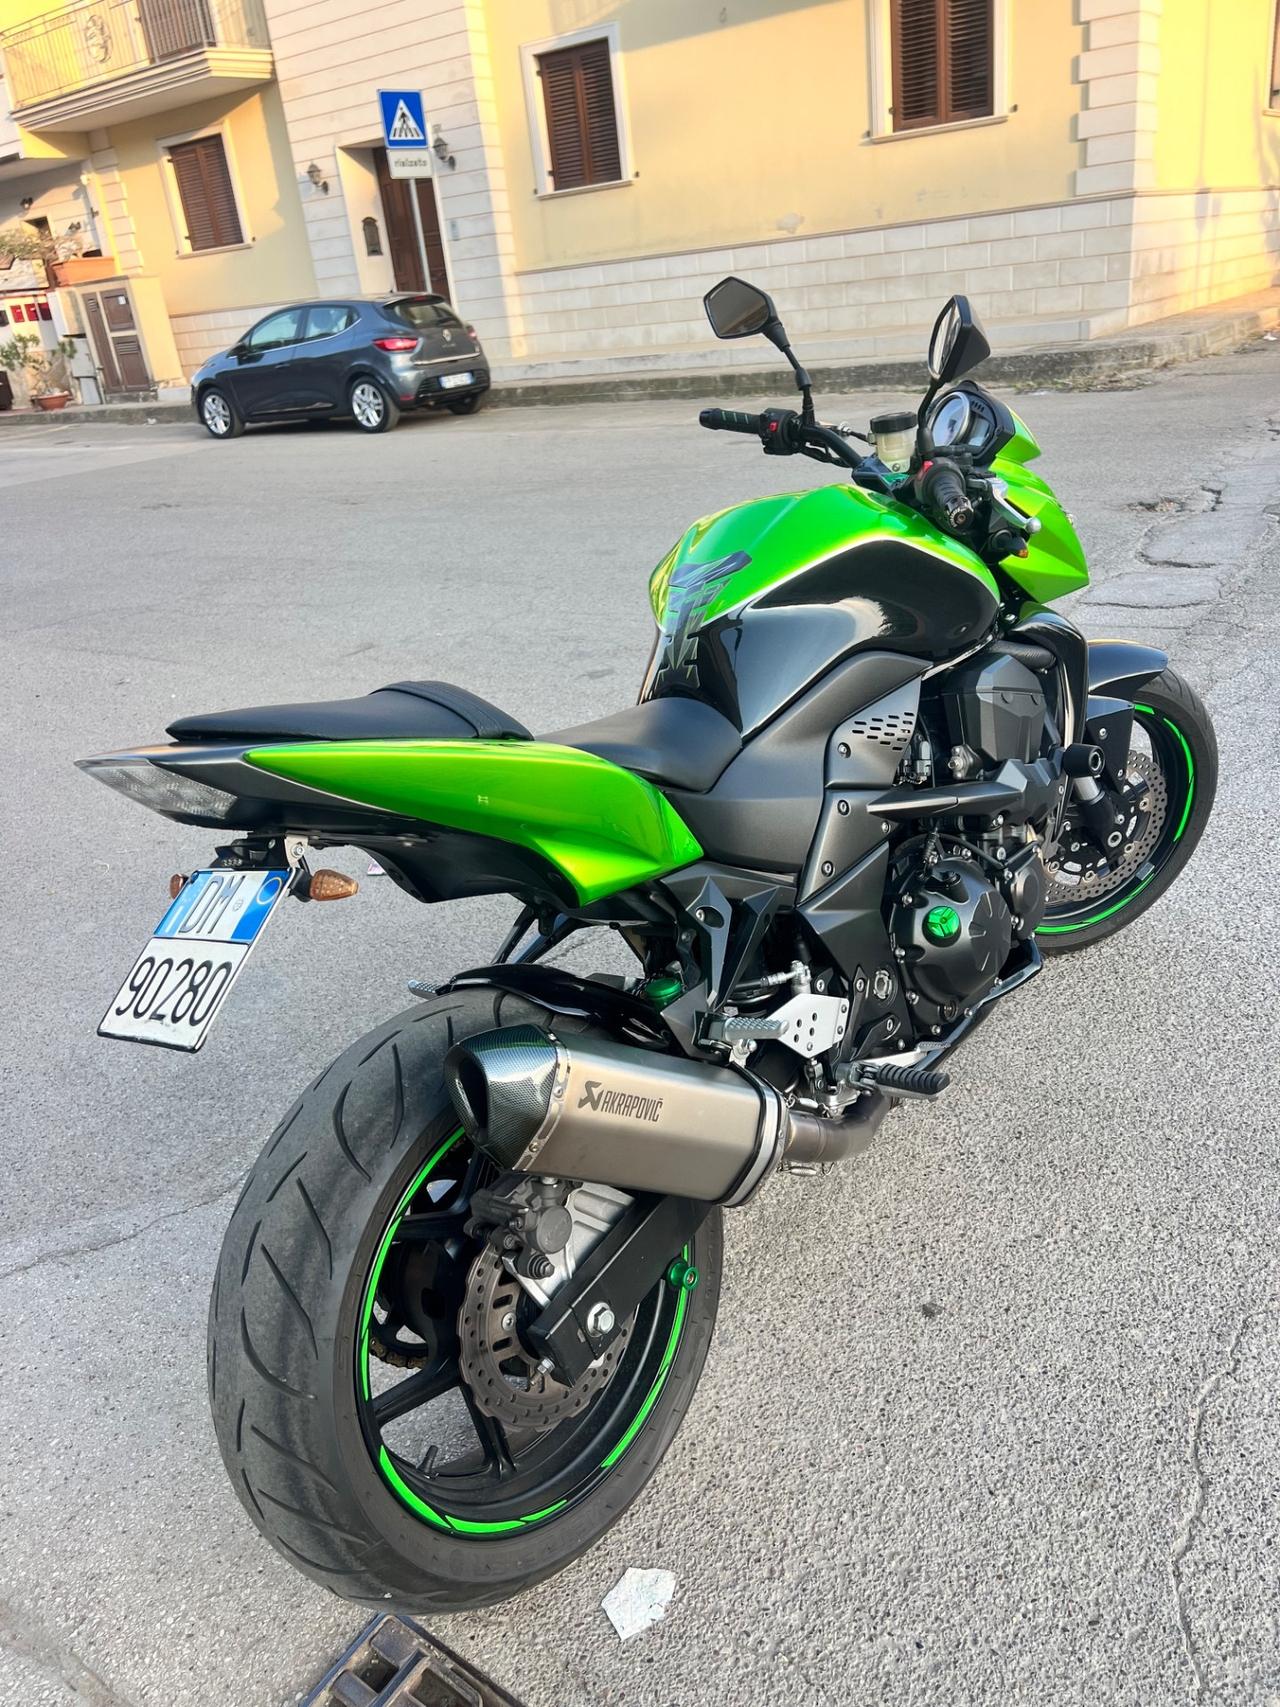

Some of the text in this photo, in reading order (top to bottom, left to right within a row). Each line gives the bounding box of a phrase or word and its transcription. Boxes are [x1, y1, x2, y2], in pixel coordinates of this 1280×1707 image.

[394, 157, 428, 168] rialzato
[178, 875, 246, 935] DM
[115, 956, 233, 1027] 90280
[600, 1090, 664, 1123] AKRAPOVIČ
